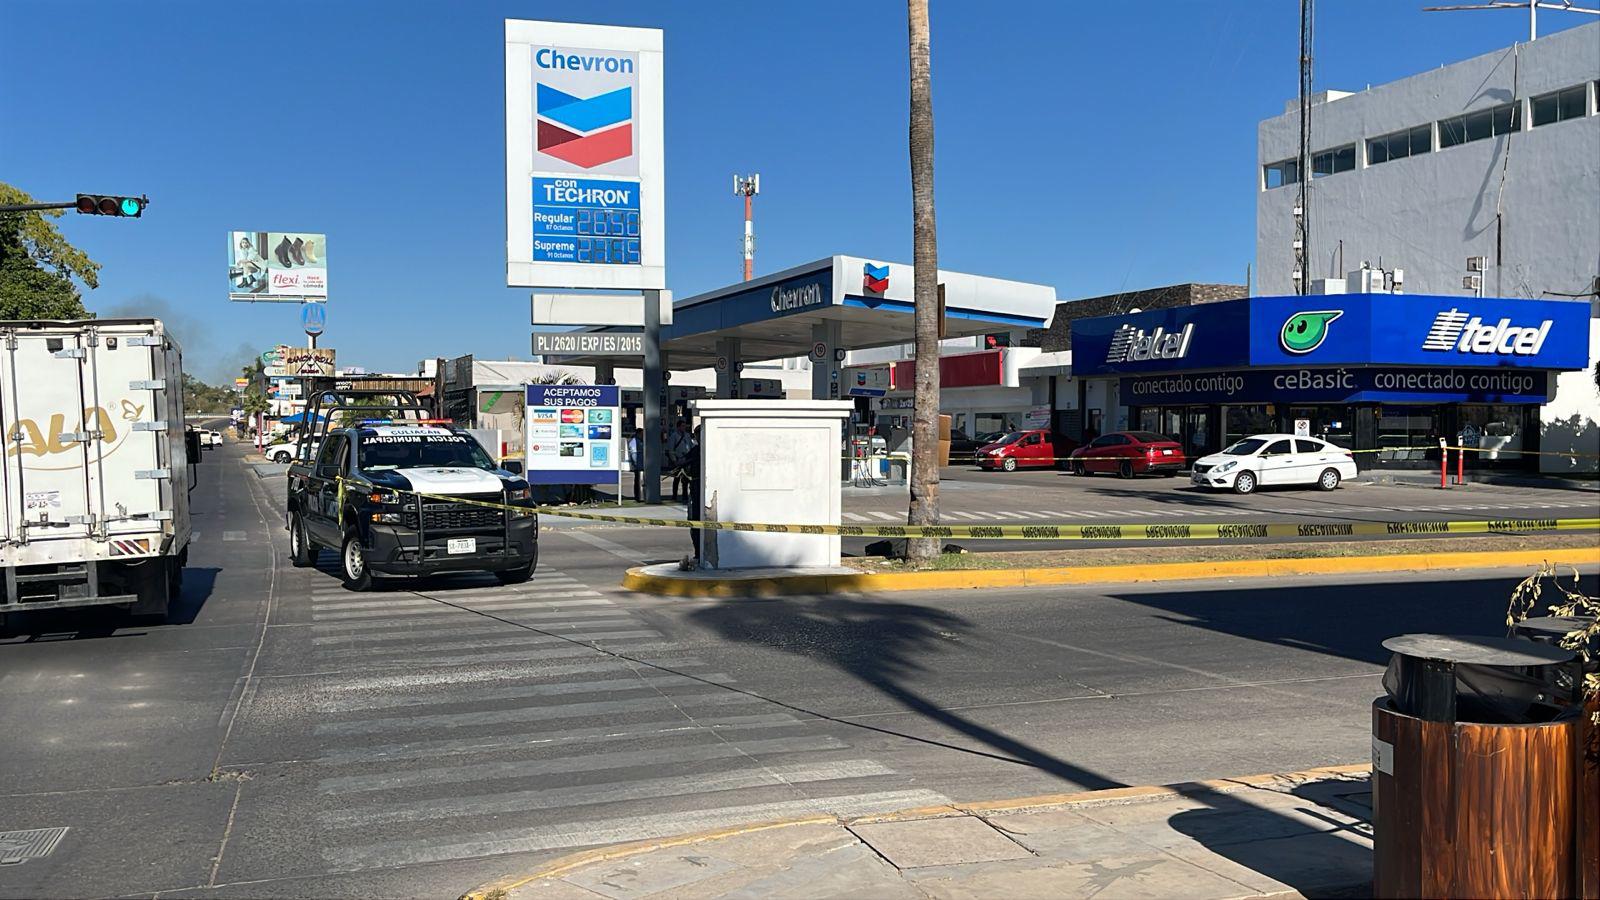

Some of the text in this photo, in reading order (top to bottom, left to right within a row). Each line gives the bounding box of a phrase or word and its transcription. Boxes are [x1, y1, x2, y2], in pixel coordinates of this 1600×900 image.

[536, 48, 633, 73] Chevron
[555, 180, 577, 188] con
[543, 185, 628, 206] TECHRON
[534, 212, 574, 224] Regular
[534, 241, 575, 252] Supreme
[273, 274, 300, 285] flexi
[771, 283, 821, 312] Chevron
[1126, 323, 1194, 362] telcel
[1456, 317, 1553, 355] telcel
[543, 388, 601, 397] ACEPTAMOS
[1132, 374, 1244, 396] conectado contigo
[1374, 371, 1533, 395] conectado contigo
[543, 398, 597, 406] SUS PAGOS
